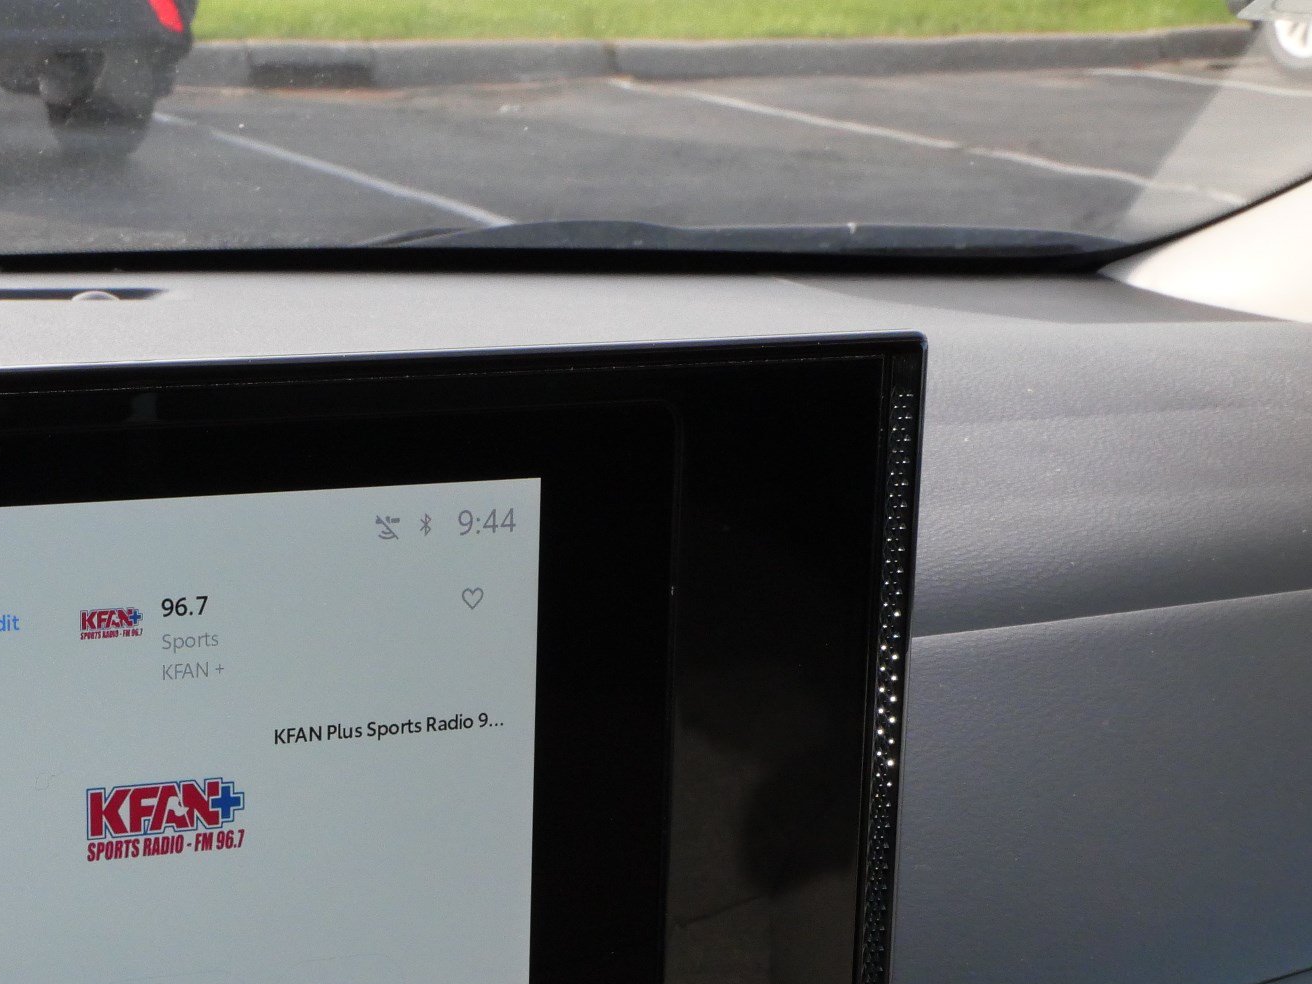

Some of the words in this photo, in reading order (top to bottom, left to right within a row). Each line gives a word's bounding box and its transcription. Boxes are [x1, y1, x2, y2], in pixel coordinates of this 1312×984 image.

[458, 508, 516, 536] 9:44
[161, 596, 209, 617] 96.7
[161, 632, 219, 653] Sports
[162, 661, 209, 681] KFAN
[274, 726, 322, 744] KFAN
[327, 722, 363, 740] Plus
[366, 718, 422, 740] Sports
[426, 713, 474, 732] Radio
[87, 838, 140, 862] SPORTS
[143, 834, 184, 856] RADIO
[194, 831, 214, 852] FM
[216, 828, 245, 850] 96.7
